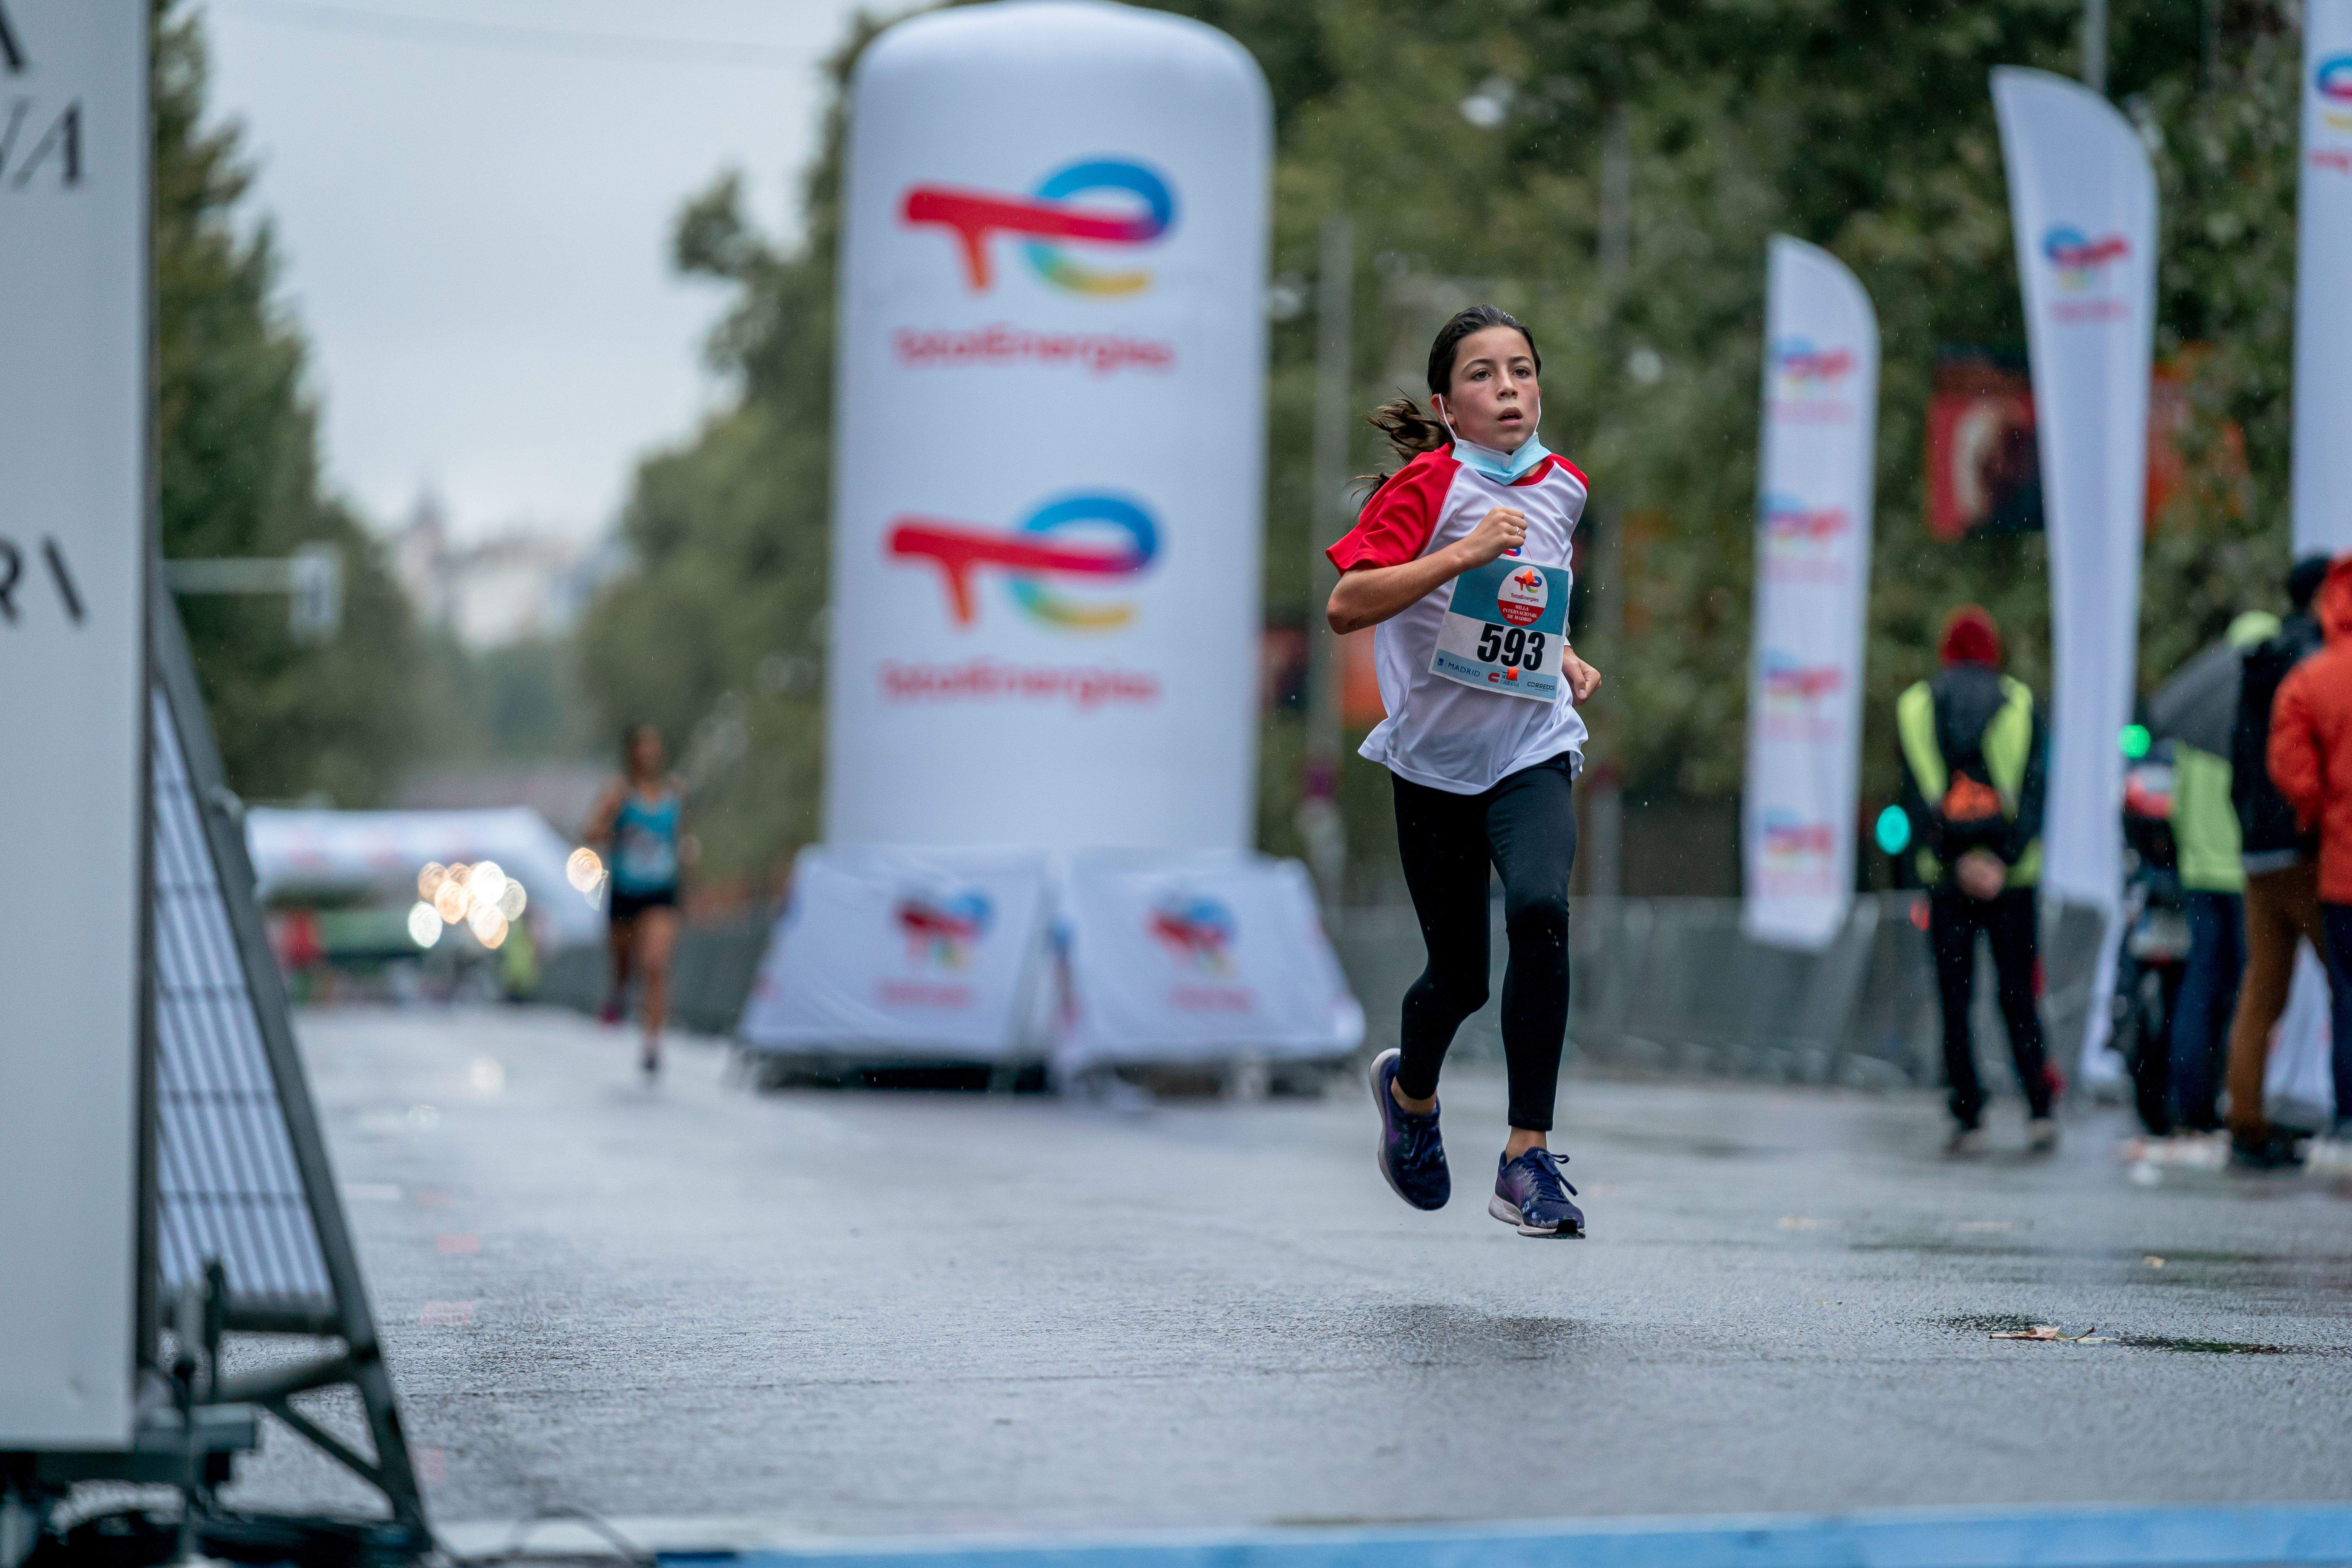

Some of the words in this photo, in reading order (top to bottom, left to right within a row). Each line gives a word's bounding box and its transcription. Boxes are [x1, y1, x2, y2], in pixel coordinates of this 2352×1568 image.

[1511, 593, 1539, 602] TotalEnergies
[1503, 608, 1538, 618] INTERNACIONAL
[1477, 622, 1546, 671] 593
[1448, 662, 1480, 677] MADRID
